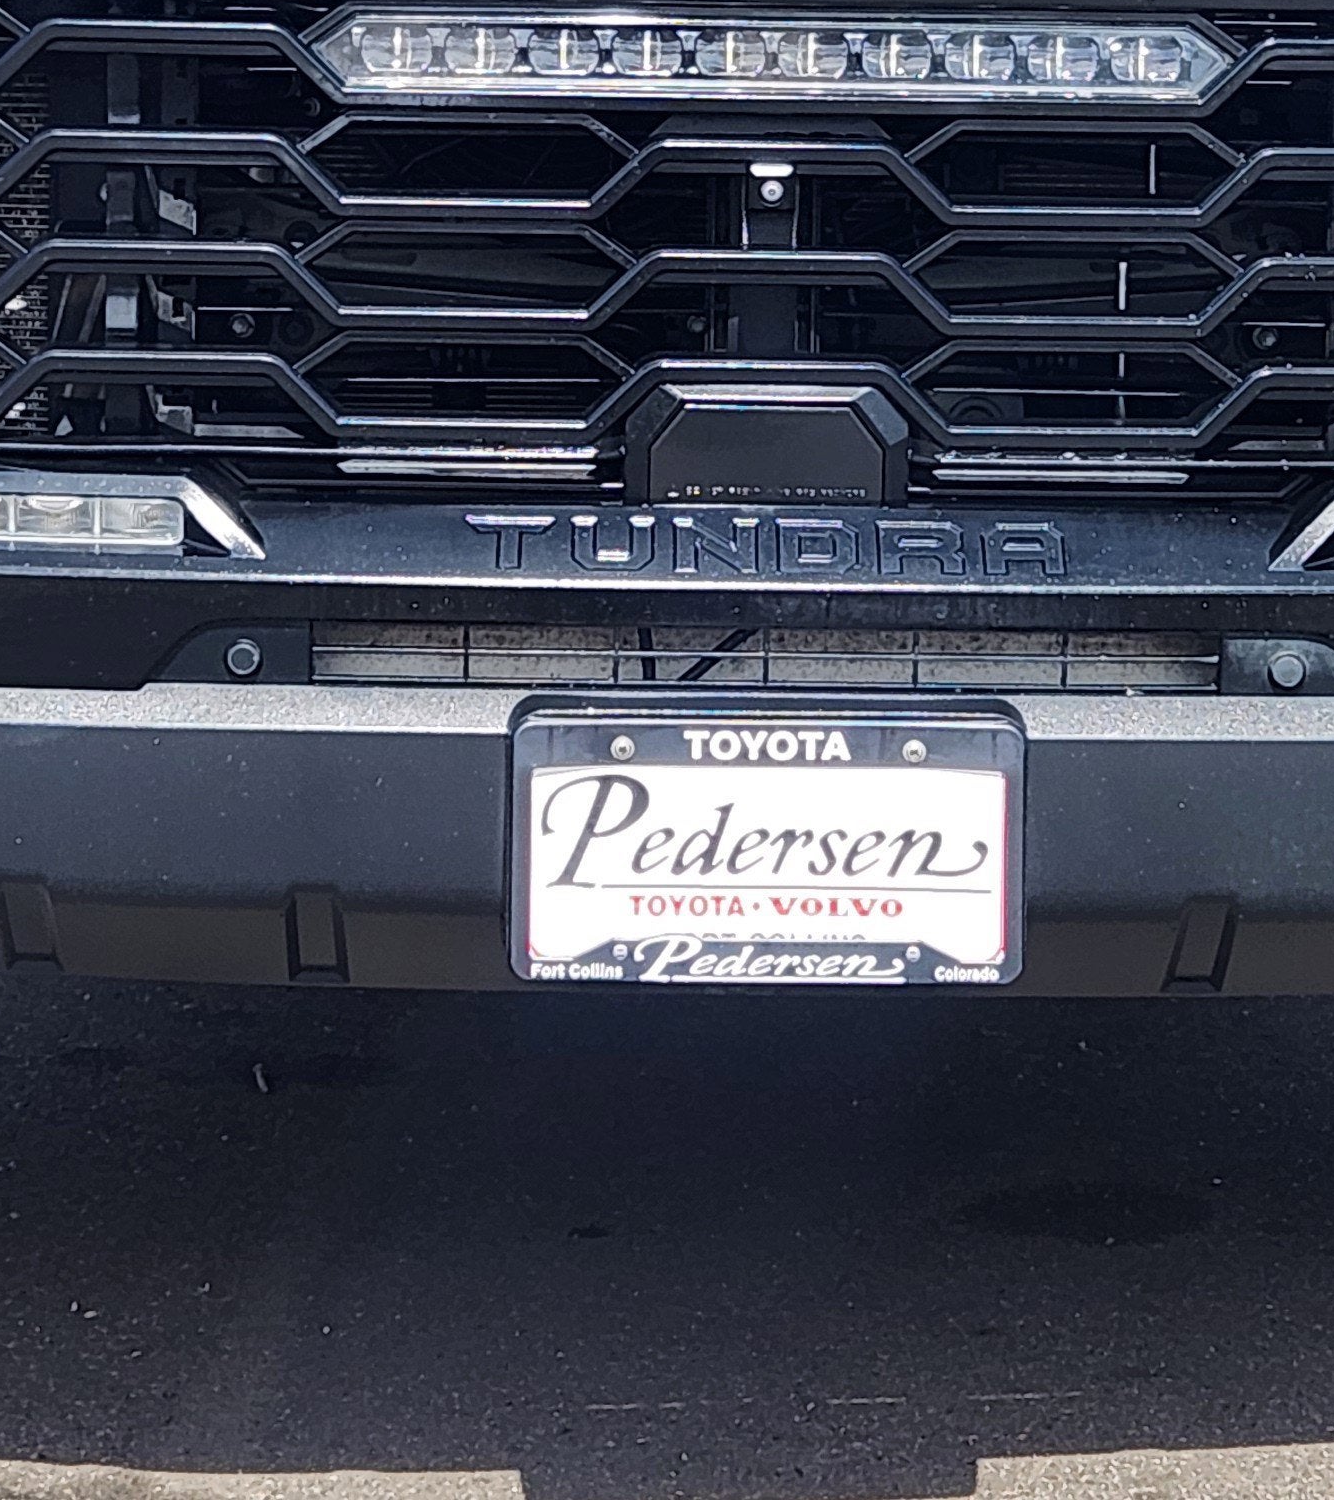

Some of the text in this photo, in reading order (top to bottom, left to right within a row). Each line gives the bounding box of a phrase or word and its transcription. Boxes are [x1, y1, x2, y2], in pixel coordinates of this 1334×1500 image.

[465, 514, 1066, 576] TUNDRA
[683, 729, 852, 763] TOYOTA
[540, 773, 990, 889] Pedersen
[629, 894, 904, 918] TOYOTA VOLVO
[530, 962, 625, 981] Fort Collins
[632, 933, 907, 984] Pedersen
[933, 964, 1001, 983] Colorado
